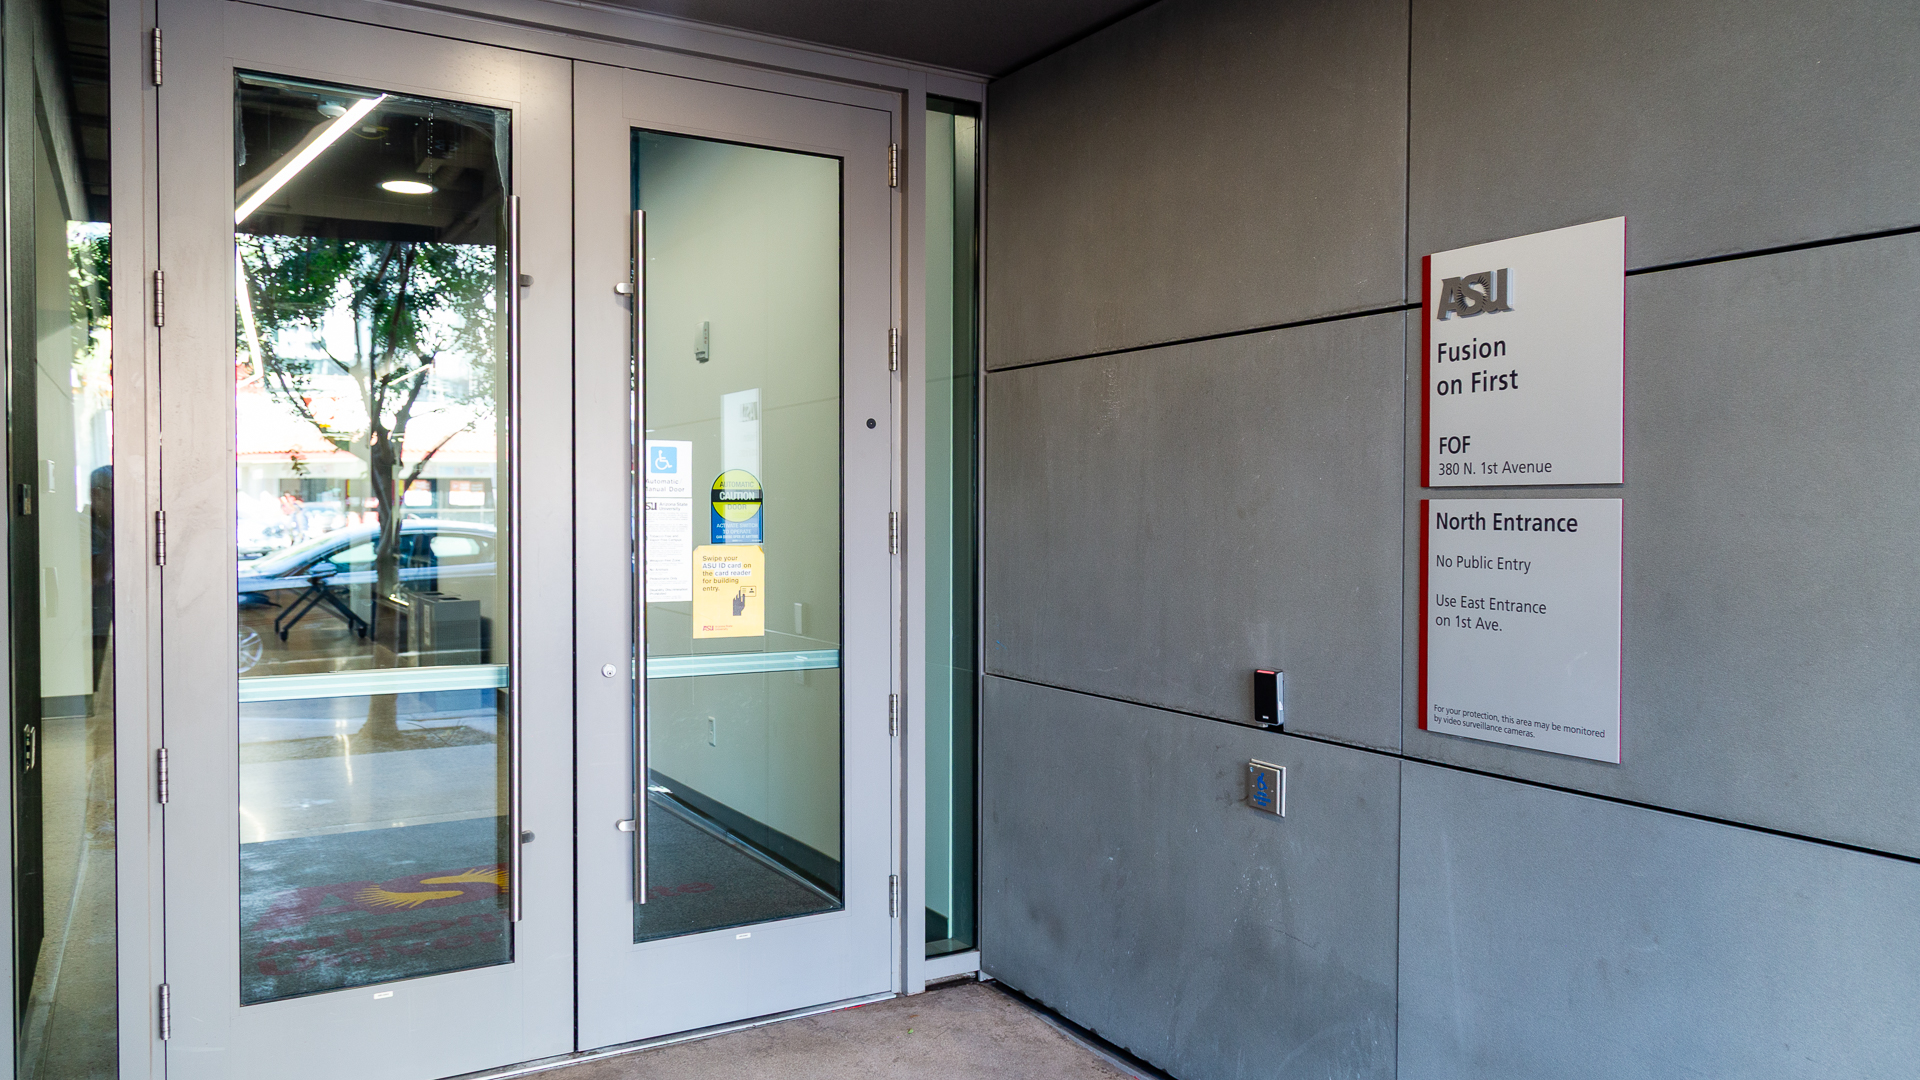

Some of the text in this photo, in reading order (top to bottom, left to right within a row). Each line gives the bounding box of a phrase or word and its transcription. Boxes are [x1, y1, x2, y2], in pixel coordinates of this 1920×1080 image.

[1437, 268, 1514, 321] ASU
[1438, 338, 1506, 363] Fusion
[1437, 369, 1519, 396] on First
[1439, 435, 1471, 454] FOF
[1438, 460, 1552, 475] 380 N. 1st Avenue
[719, 491, 755, 500] CAUTION
[646, 501, 658, 511] SU
[1436, 511, 1578, 532] North Entrance
[1436, 555, 1531, 574] No Public Entry
[1436, 594, 1547, 614] Use East Entrance
[1435, 615, 1502, 631] on 1st Ave.
[1434, 704, 1606, 738] For your protection, this area may be monitored
[1434, 714, 1536, 739] by video surveillance cameras.
[250, 862, 509, 931] AS
